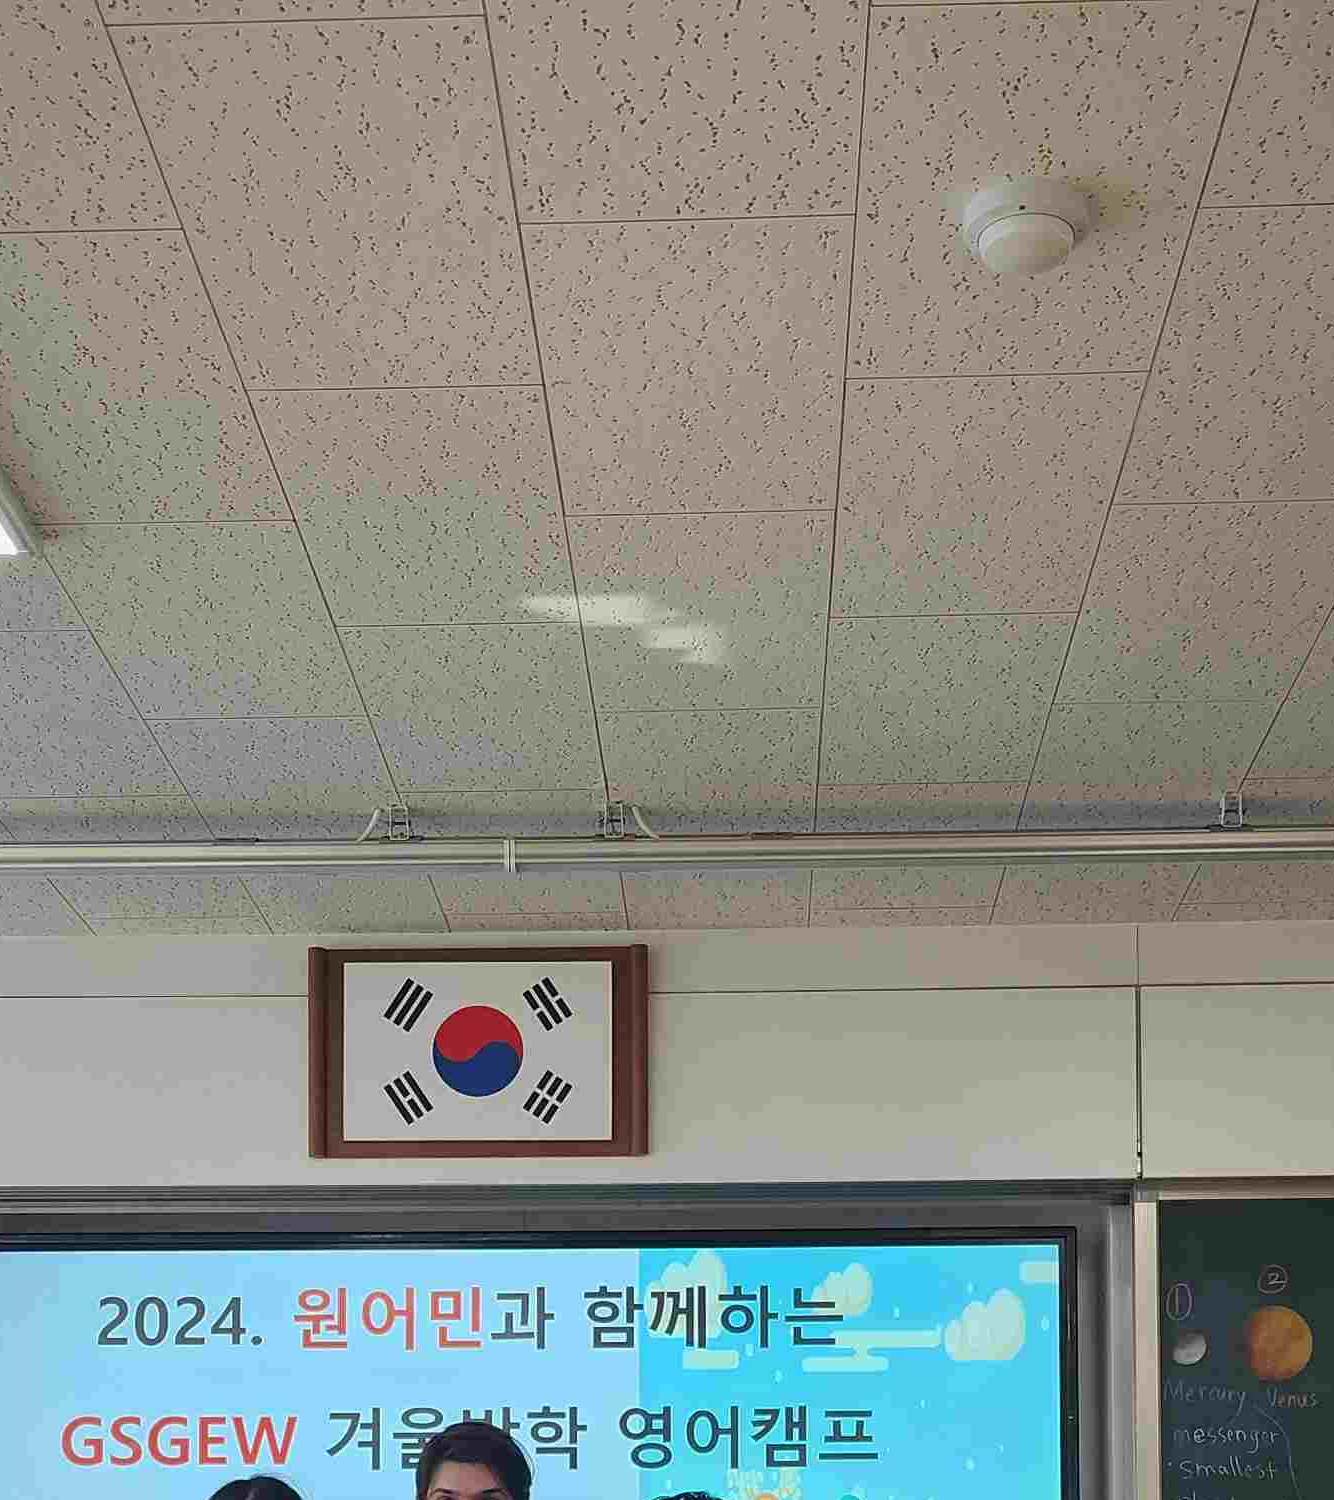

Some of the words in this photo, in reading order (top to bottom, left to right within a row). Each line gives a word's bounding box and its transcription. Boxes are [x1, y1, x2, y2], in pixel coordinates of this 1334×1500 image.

[97, 1296, 265, 1346] 2024.
[294, 1286, 556, 1350] 원어민과
[584, 1285, 844, 1350] 함께하는
[61, 1415, 297, 1467] GSGEW
[619, 1405, 879, 1470] 영어캠프
